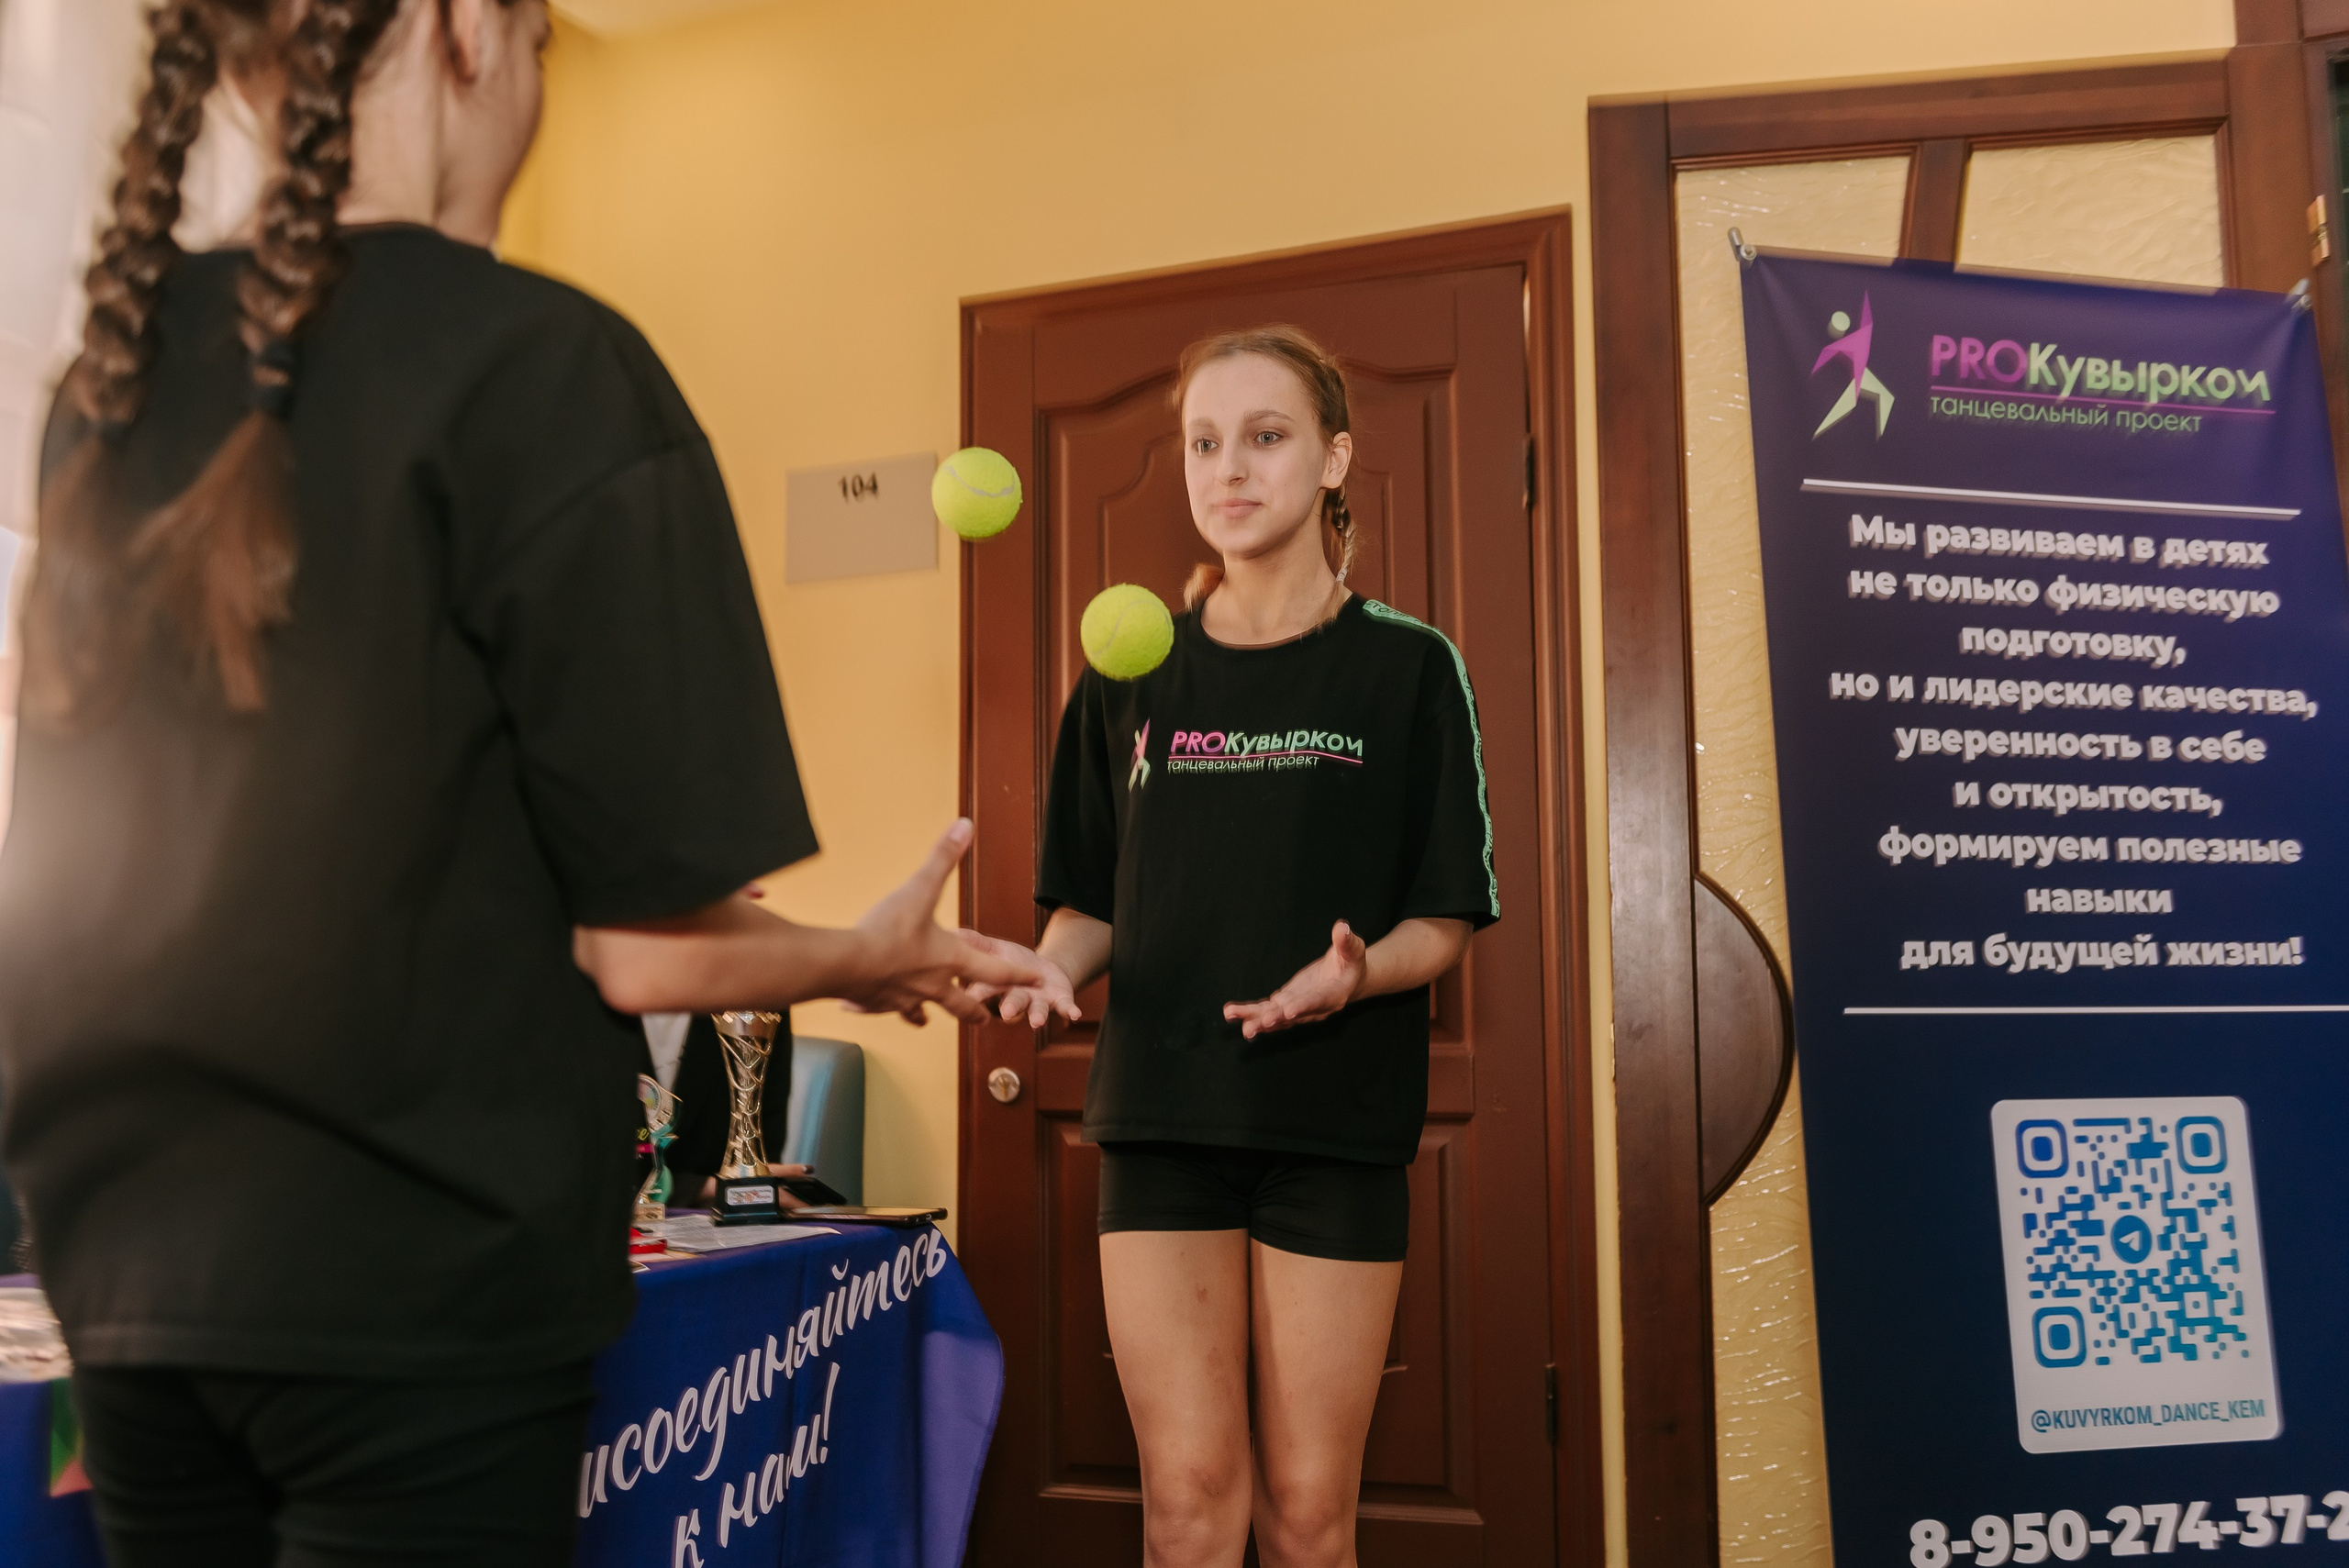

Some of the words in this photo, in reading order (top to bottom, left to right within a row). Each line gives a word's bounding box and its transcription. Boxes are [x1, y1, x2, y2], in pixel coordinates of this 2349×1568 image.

[1931, 395, 2110, 427] танцевальный
[2115, 408, 2203, 435] проект
[839, 472, 878, 500] 104
[1849, 514, 1916, 548] Мы
[1926, 523, 2124, 560] развиваем
[2134, 536, 2154, 560] в
[2163, 538, 2268, 566] детях
[1849, 570, 1898, 596] не
[1906, 573, 2040, 606] только
[2047, 575, 2280, 620] физическую
[1960, 626, 2188, 667] подготовку,
[1830, 673, 1879, 699] но
[1889, 675, 1914, 699] и
[1924, 676, 2133, 710] лидерские
[2141, 684, 2318, 719] качества,
[1167, 756, 1264, 772] танцевальный
[1268, 754, 1319, 771] проект
[1895, 727, 2143, 762] уверенность
[2149, 739, 2172, 760] в
[2180, 729, 2267, 762] себе
[1954, 782, 1980, 806] и
[1988, 784, 2223, 817] открытость,
[1878, 826, 2109, 865] формируем
[2117, 837, 2302, 864] полезные
[2026, 887, 2173, 914] навыки
[1901, 940, 1975, 970] для
[1982, 934, 2159, 973] будущей
[2166, 937, 2304, 966] жизни!
[578, 1229, 948, 1518] исоединяйтесь
[2031, 1399, 2266, 1433] @KUVYRKOM_DANCE_KEM
[674, 1508, 705, 1568] к
[718, 1362, 840, 1548] нам!
[1909, 1490, 2349, 1568] 8-950-274-37-2
